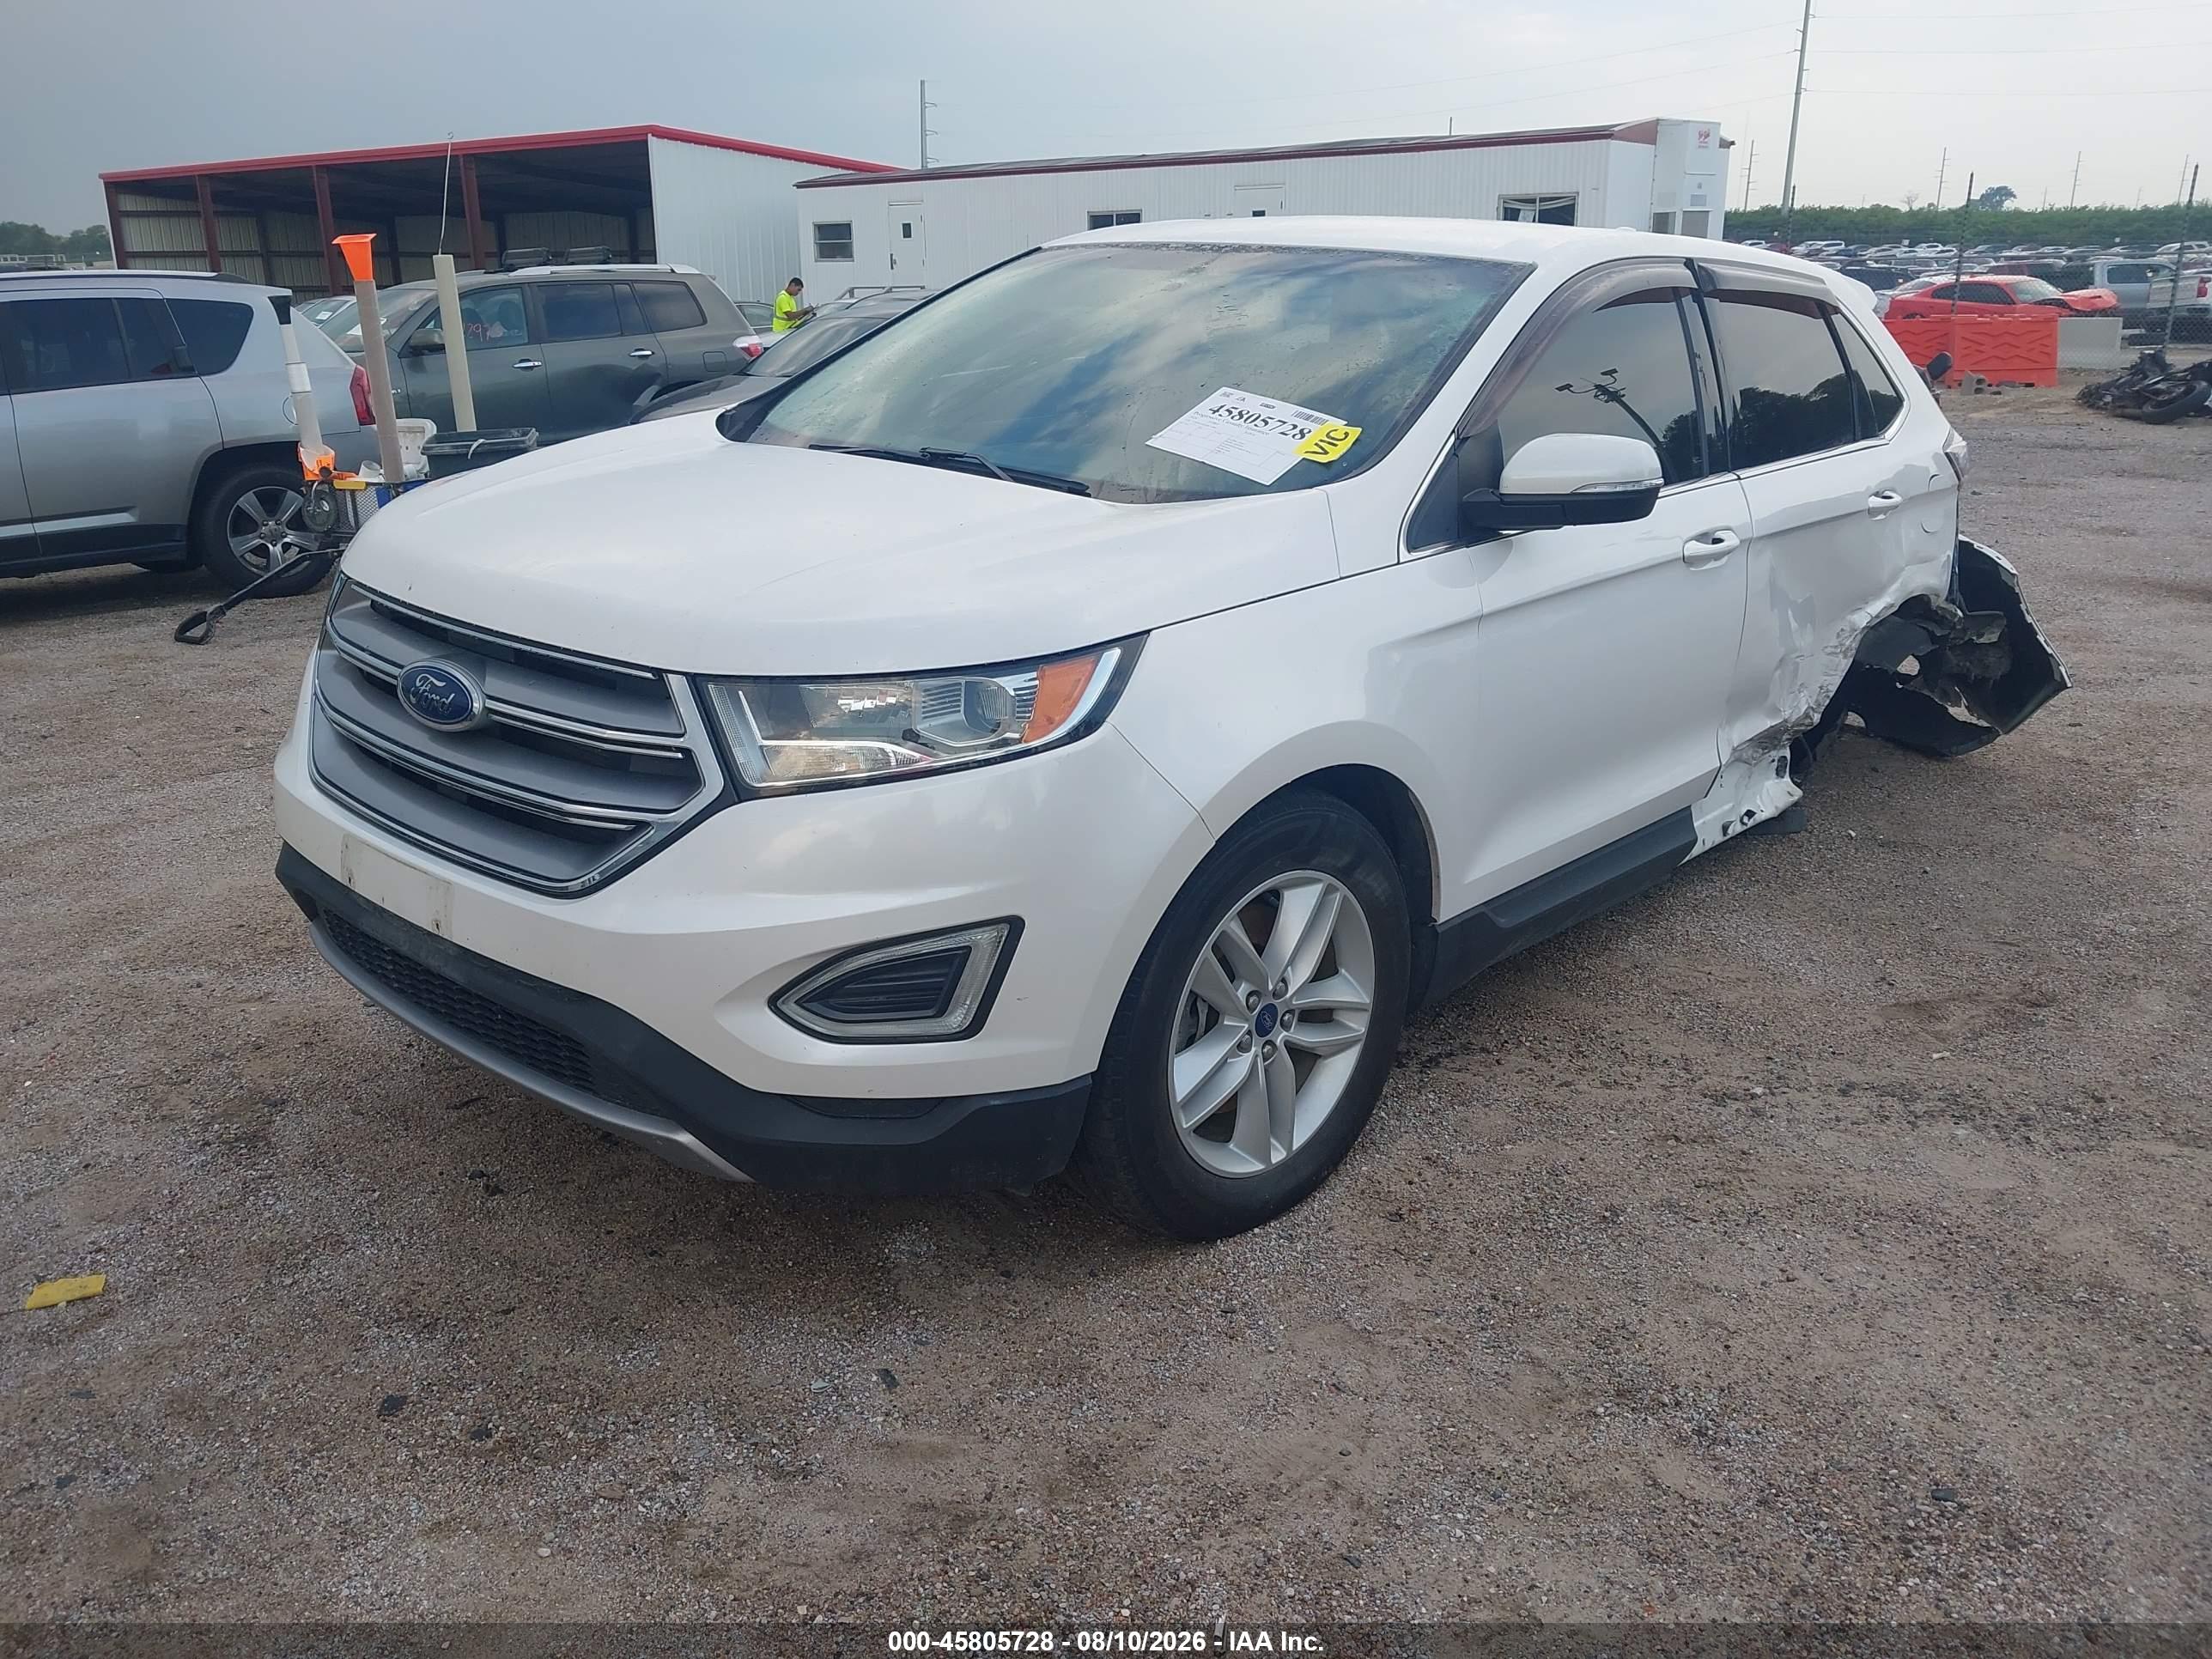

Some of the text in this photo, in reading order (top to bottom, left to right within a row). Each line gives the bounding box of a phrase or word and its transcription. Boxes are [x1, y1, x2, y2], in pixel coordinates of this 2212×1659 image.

[1209, 404, 1312, 440] 45805728
[1304, 428, 1349, 455] VIC
[410, 675, 455, 714] Ford
